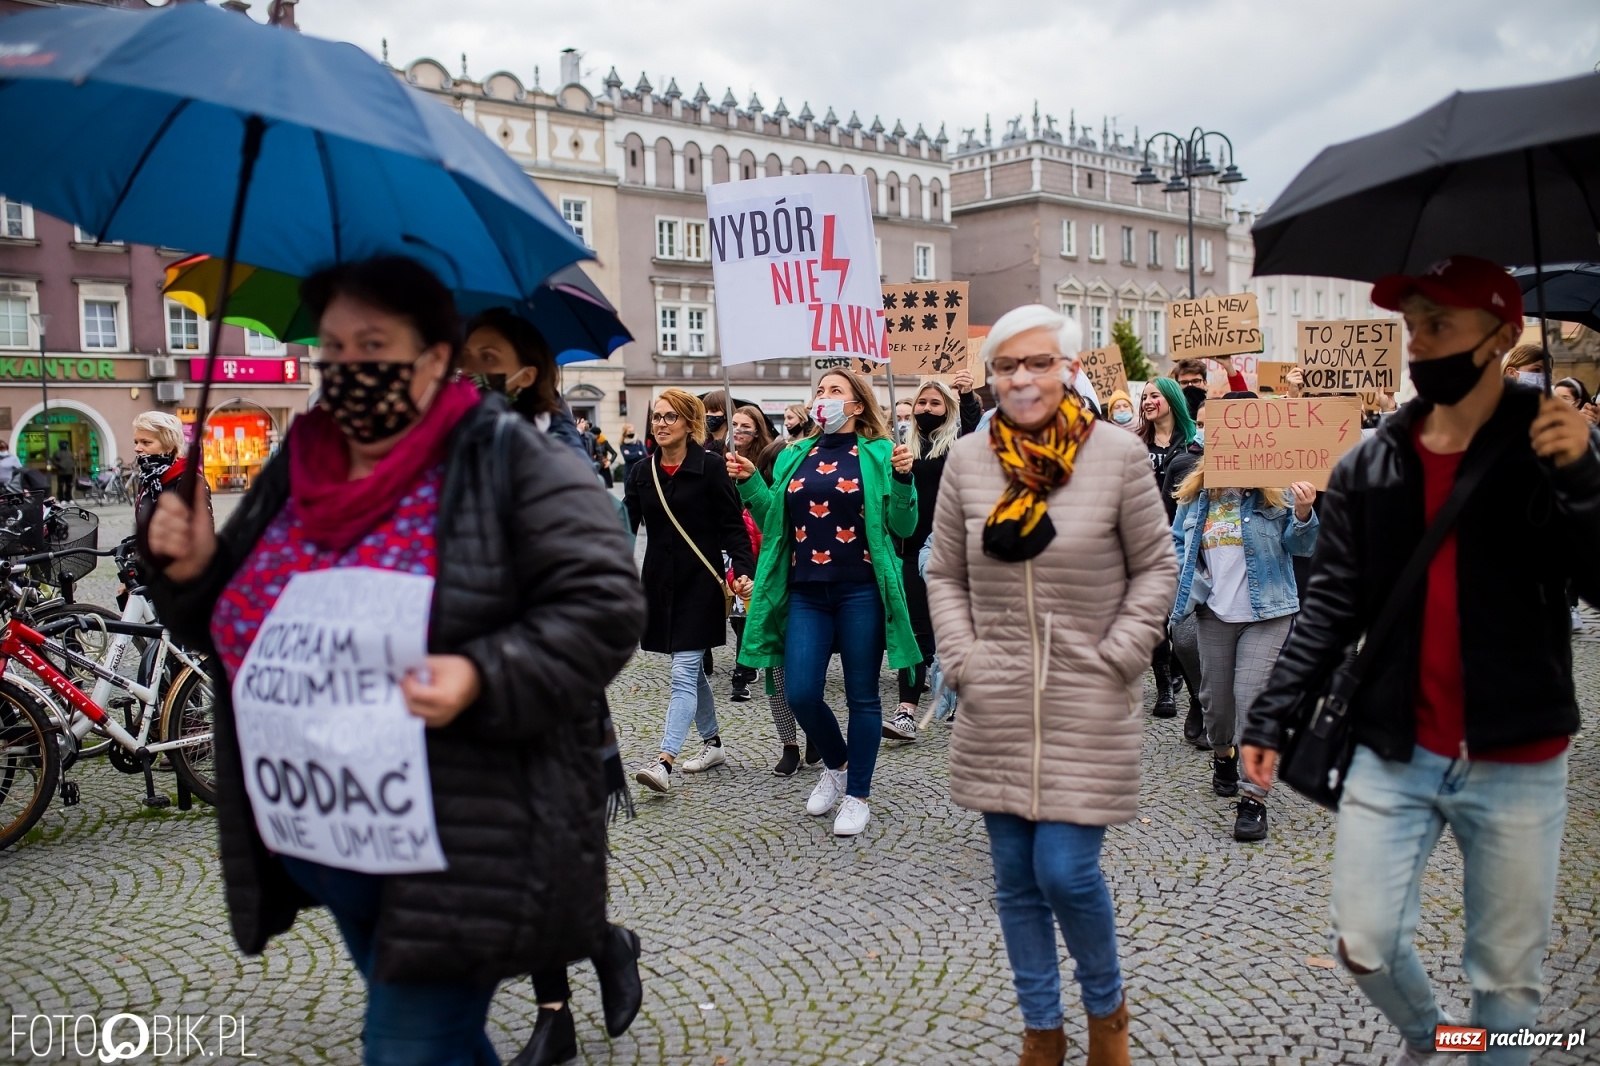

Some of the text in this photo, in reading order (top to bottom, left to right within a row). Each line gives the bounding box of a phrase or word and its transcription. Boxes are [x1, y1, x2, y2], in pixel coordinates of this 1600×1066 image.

[770, 259, 821, 305] NIE
[1173, 298, 1249, 319] REAL MEN
[1189, 315, 1230, 334] ARE
[1304, 323, 1398, 348] TO JEST
[1304, 348, 1388, 367] WOJNA Z
[0, 359, 116, 379] KANTOR
[1086, 368, 1101, 379] ÓL
[1302, 369, 1393, 389] KOBIETAMI
[1223, 401, 1324, 429] GODEK
[1232, 431, 1277, 449] WAS
[1213, 449, 1329, 470] THE IMPOSTOR
[254, 756, 413, 817] ODDAĆ
[266, 813, 315, 850] NIE
